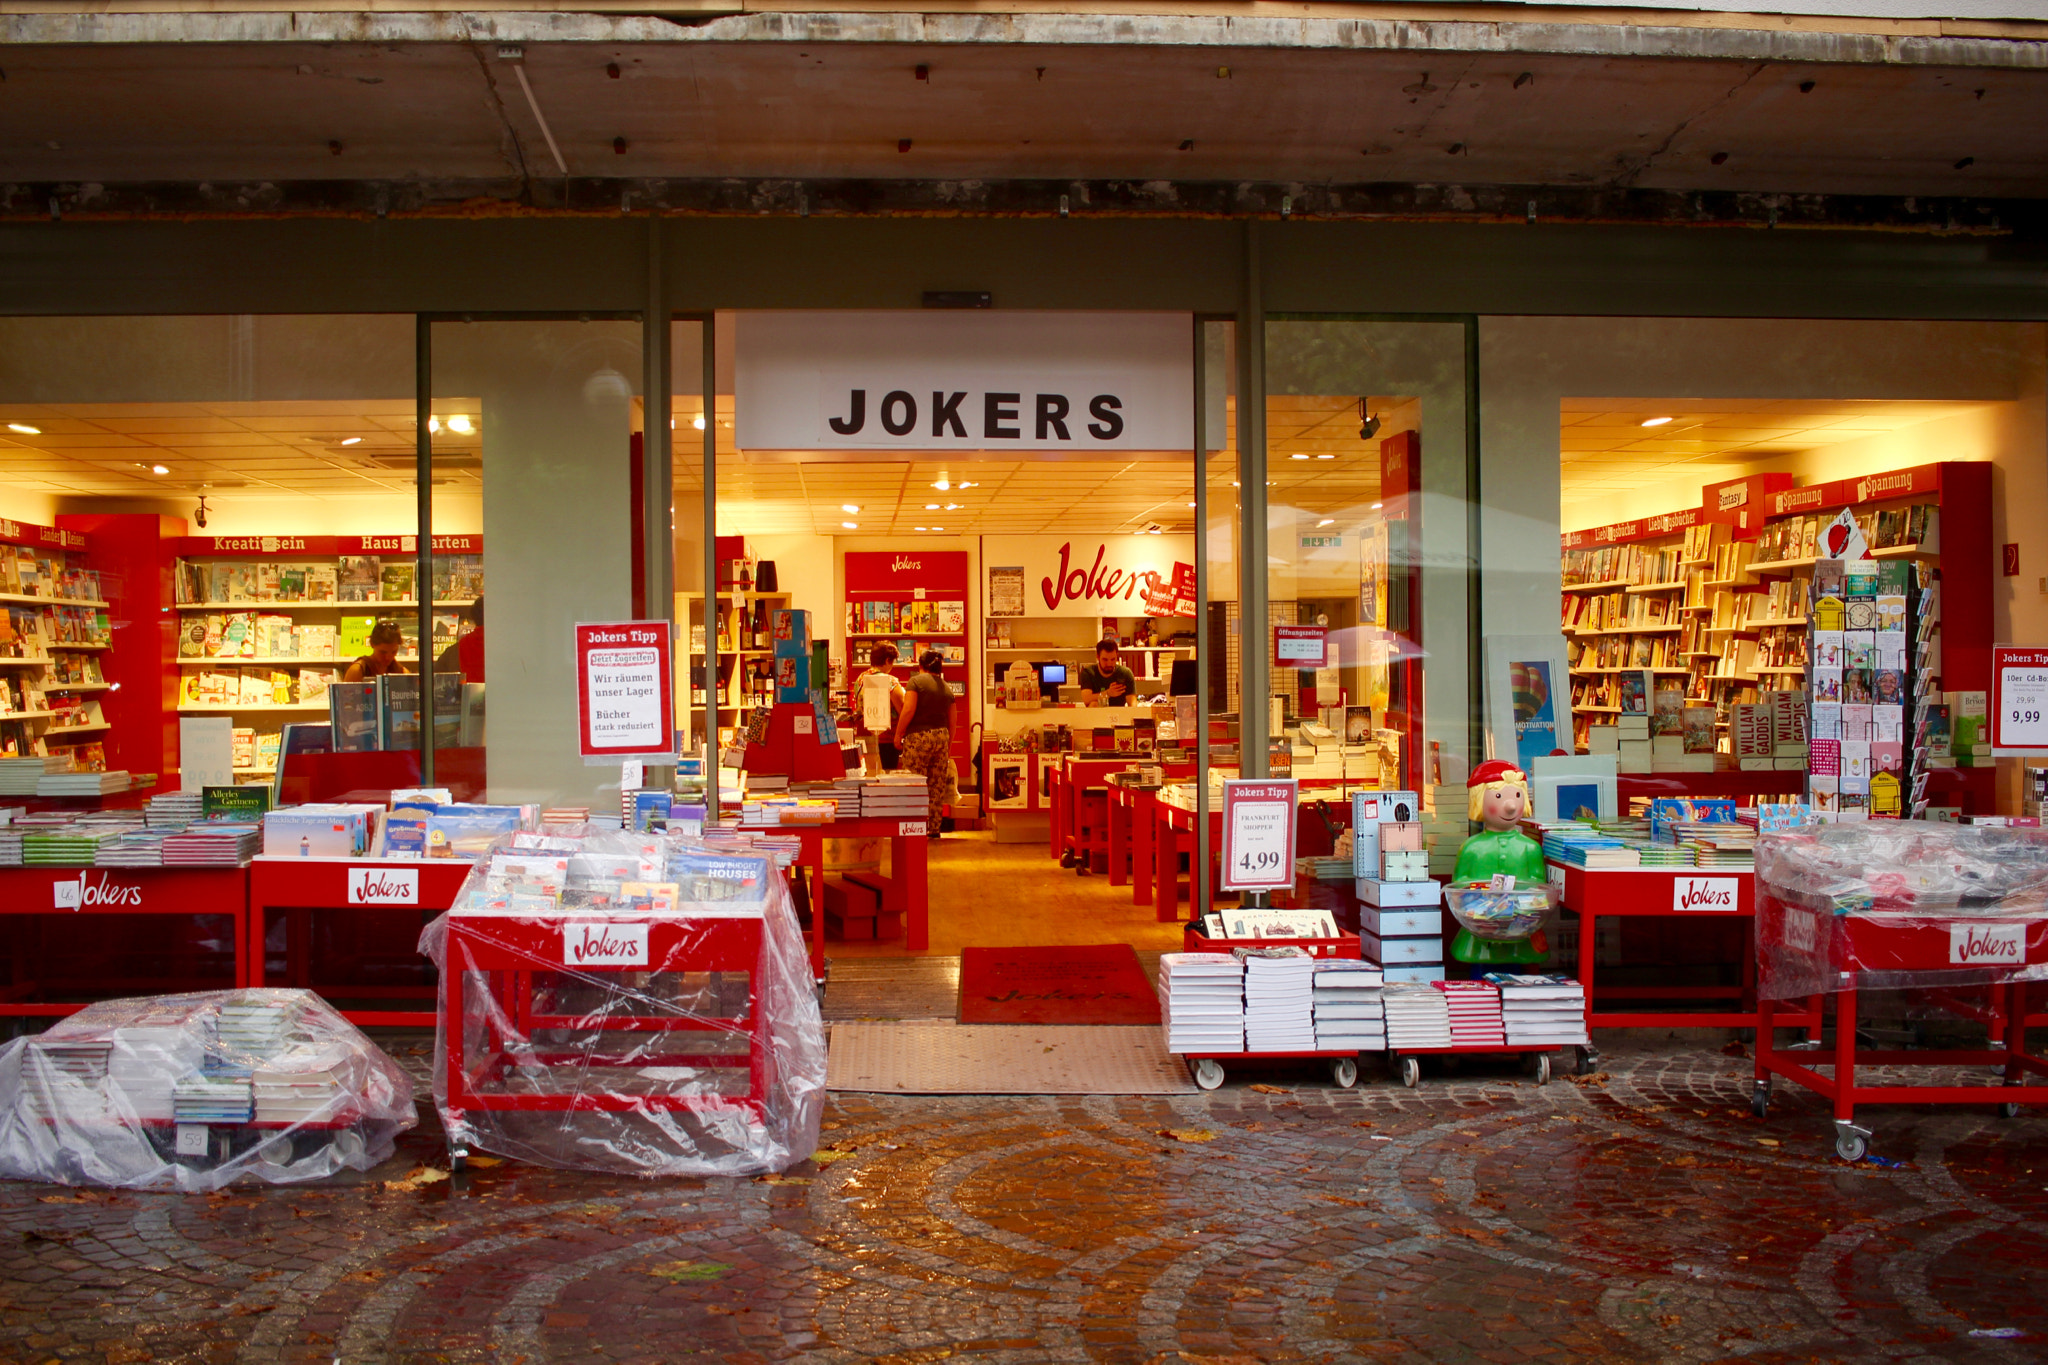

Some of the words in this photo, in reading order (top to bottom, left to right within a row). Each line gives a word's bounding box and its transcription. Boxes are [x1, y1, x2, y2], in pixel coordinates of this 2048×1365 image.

[828, 389, 1124, 441] JOKERS
[1866, 472, 1913, 497] Spannung
[1783, 488, 1822, 511] Spannung
[1647, 510, 1697, 533] Lieblgsbücher
[1595, 520, 1637, 542] Lieblgsbücher
[214, 536, 265, 550] Kreati
[361, 536, 399, 550] Haus
[431, 538, 471, 549] arten
[891, 555, 922, 573] Jokers
[1042, 541, 1159, 611] Jokers
[432, 635, 455, 643] DERNE
[588, 631, 628, 643] Jokers
[630, 630, 658, 643] Tipp
[592, 653, 612, 663] Jetzt
[2002, 653, 2033, 663] Jokers
[594, 673, 612, 683] Wir
[615, 672, 654, 683] räumen
[2007, 674, 2023, 682] 10er
[2026, 674, 2048, 682] Cd-Bo
[391, 690, 420, 701] Baureihe
[595, 688, 623, 698] unser
[626, 687, 654, 697] Lager
[596, 709, 631, 719] Bücher
[1778, 692, 1792, 742] WILLIAM
[2012, 710, 2041, 724] 9,99
[594, 722, 615, 731] stark
[617, 721, 655, 731] reduziert
[1515, 721, 1555, 729] MOTIVATION
[1741, 706, 1755, 755] WILLIAM
[1756, 716, 1770, 755] GADDIS
[210, 789, 240, 799] Allerley
[1234, 787, 1265, 798] Jokers
[1267, 787, 1289, 798] Tipp
[1240, 814, 1281, 822] FRANKFURT
[902, 823, 924, 835] Jokers
[709, 860, 726, 869] LOW
[728, 861, 757, 869] BUDGET
[1239, 850, 1280, 874] 4,99
[708, 869, 757, 879] HOUSES
[73, 869, 142, 912] Jokers
[356, 871, 411, 902] Jokers
[1681, 880, 1731, 910] Jokers
[573, 926, 639, 963] Jokers
[1958, 926, 2017, 962] Jokers
